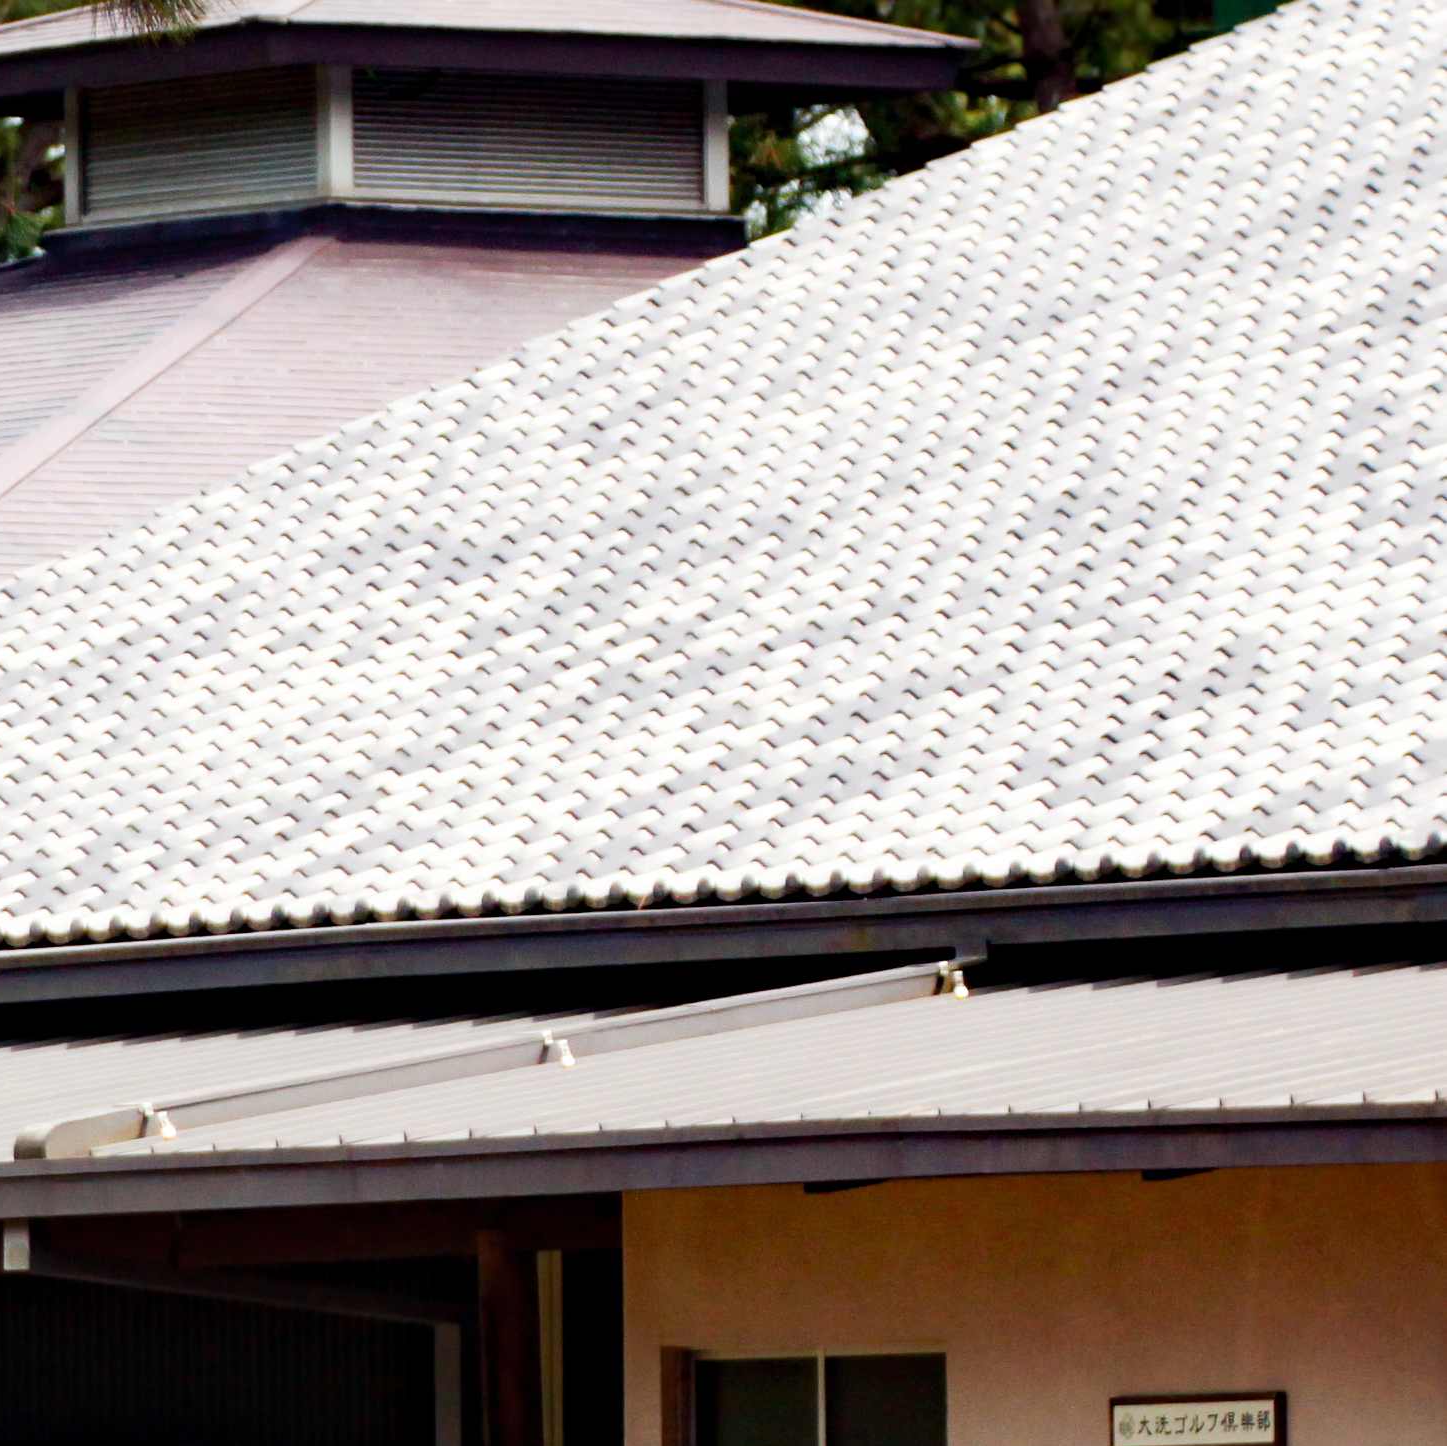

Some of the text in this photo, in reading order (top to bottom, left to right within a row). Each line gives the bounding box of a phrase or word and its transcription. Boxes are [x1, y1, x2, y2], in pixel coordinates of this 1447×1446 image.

[1137, 1410, 1272, 1436] 大洗ゴルフ倶楽部
